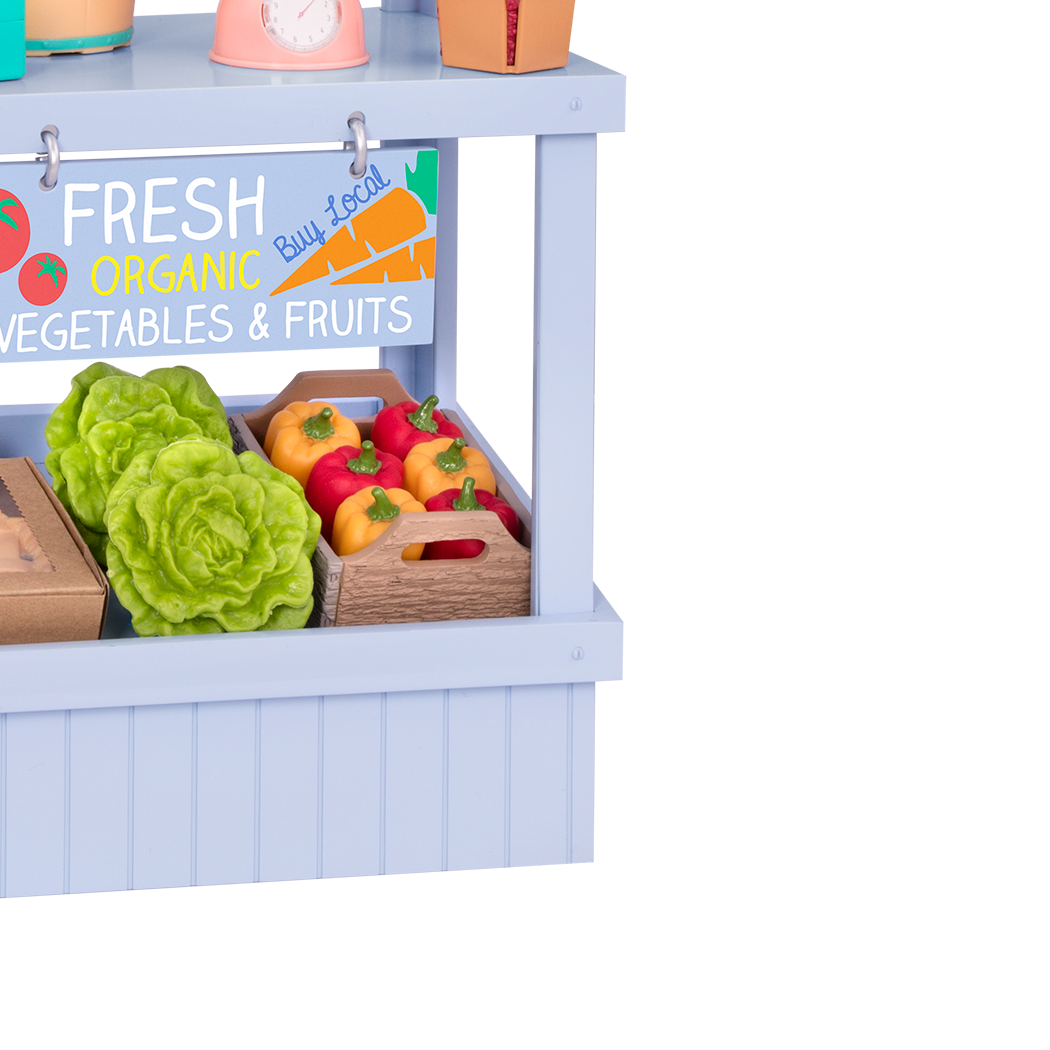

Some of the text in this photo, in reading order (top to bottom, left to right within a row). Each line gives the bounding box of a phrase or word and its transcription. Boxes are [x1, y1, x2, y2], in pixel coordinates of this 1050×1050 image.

[63, 175, 265, 247] FRESH
[272, 164, 391, 264] Buy Local
[91, 249, 261, 296] ORGANIC
[248, 301, 270, 340] &
[285, 295, 413, 339] FRUITS
